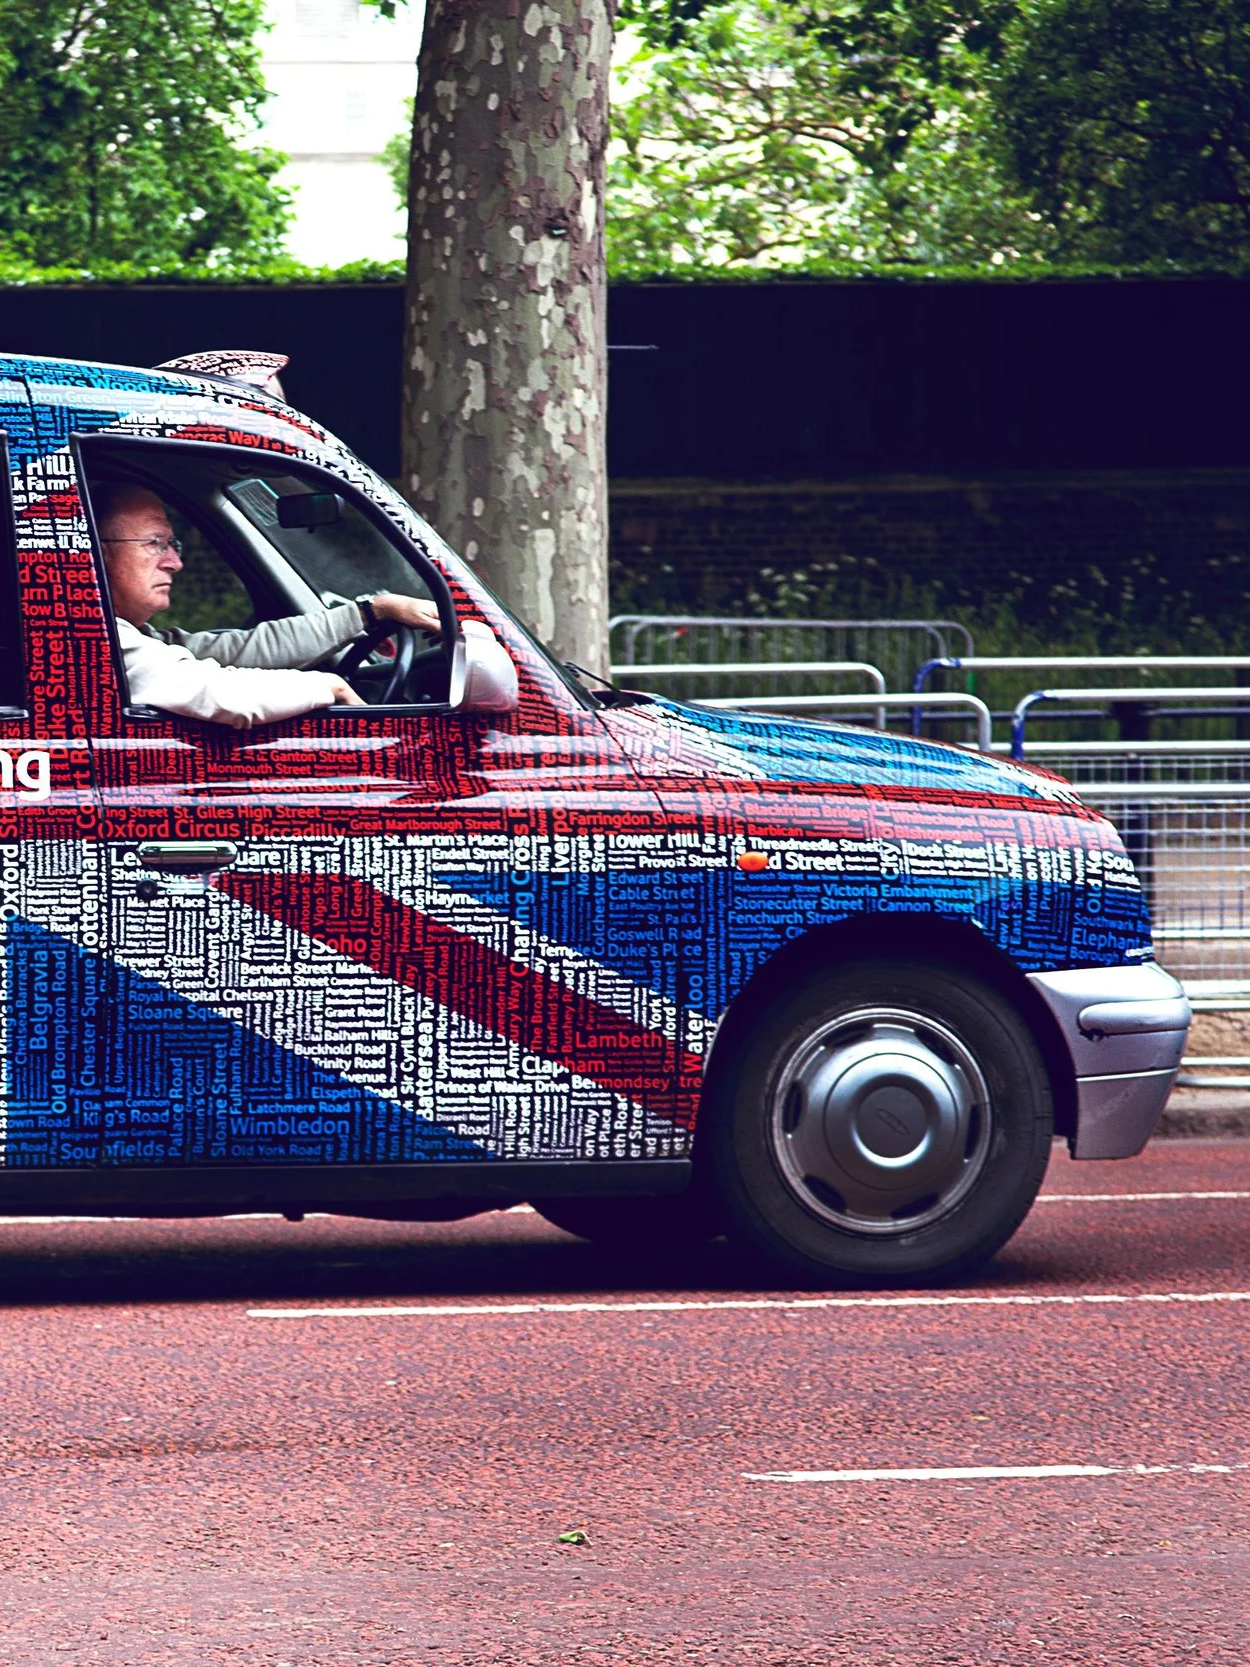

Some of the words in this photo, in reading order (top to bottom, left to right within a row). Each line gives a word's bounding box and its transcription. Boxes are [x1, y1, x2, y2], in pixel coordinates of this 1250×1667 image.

[90, 379, 151, 394] Wood
[50, 631, 65, 698] Street
[173, 806, 193, 819] St.
[196, 806, 235, 819] Giles
[238, 805, 275, 819] High
[278, 805, 322, 818] Street
[569, 813, 650, 826] Farringdon
[653, 812, 697, 824] Street
[174, 819, 240, 838] Circus
[251, 823, 346, 845] Piccadilly
[350, 819, 383, 831] Great
[385, 818, 463, 833] Marlborough
[465, 818, 501, 831] Street
[608, 834, 664, 848] Tower
[667, 834, 702, 848] Hill
[749, 837, 838, 852] Threadneedle
[840, 839, 880, 853] Street
[608, 872, 660, 884] Edward
[426, 891, 510, 908] Haymarket
[608, 887, 650, 900] Cable
[823, 884, 878, 897] Victoria
[881, 885, 974, 900] Embankment
[734, 897, 818, 912] Stonecutter
[821, 898, 864, 910] Street
[877, 900, 931, 913] Cannon
[934, 900, 975, 913] Street
[728, 911, 803, 924] Fenchurch
[1073, 913, 1134, 930] Southwark
[607, 928, 664, 941] Goswell
[1072, 928, 1140, 950] Elephant
[311, 934, 367, 955] Soho
[607, 944, 659, 957] Duke's
[1070, 947, 1119, 965] Borough
[52, 951, 67, 993] Road
[82, 958, 98, 1018] Square
[30, 951, 51, 1050] Belgravia
[128, 1005, 184, 1019] Sloane
[187, 1004, 243, 1021] Square
[51, 998, 68, 1080] Brompton
[575, 1032, 663, 1049] Lambeth
[80, 1021, 96, 1087] Chester
[415, 1021, 434, 1122] Battersea
[522, 1055, 606, 1077] Clapham
[435, 1082, 476, 1094] Prince
[479, 1081, 492, 1094] of
[494, 1082, 534, 1094] Wales
[535, 1080, 570, 1093] Drive
[571, 1075, 670, 1091] Bermondsey
[51, 1084, 67, 1114] Old
[248, 1102, 316, 1114] Latchmere
[319, 1102, 350, 1113] Road
[230, 1117, 350, 1135] Wimbledon
